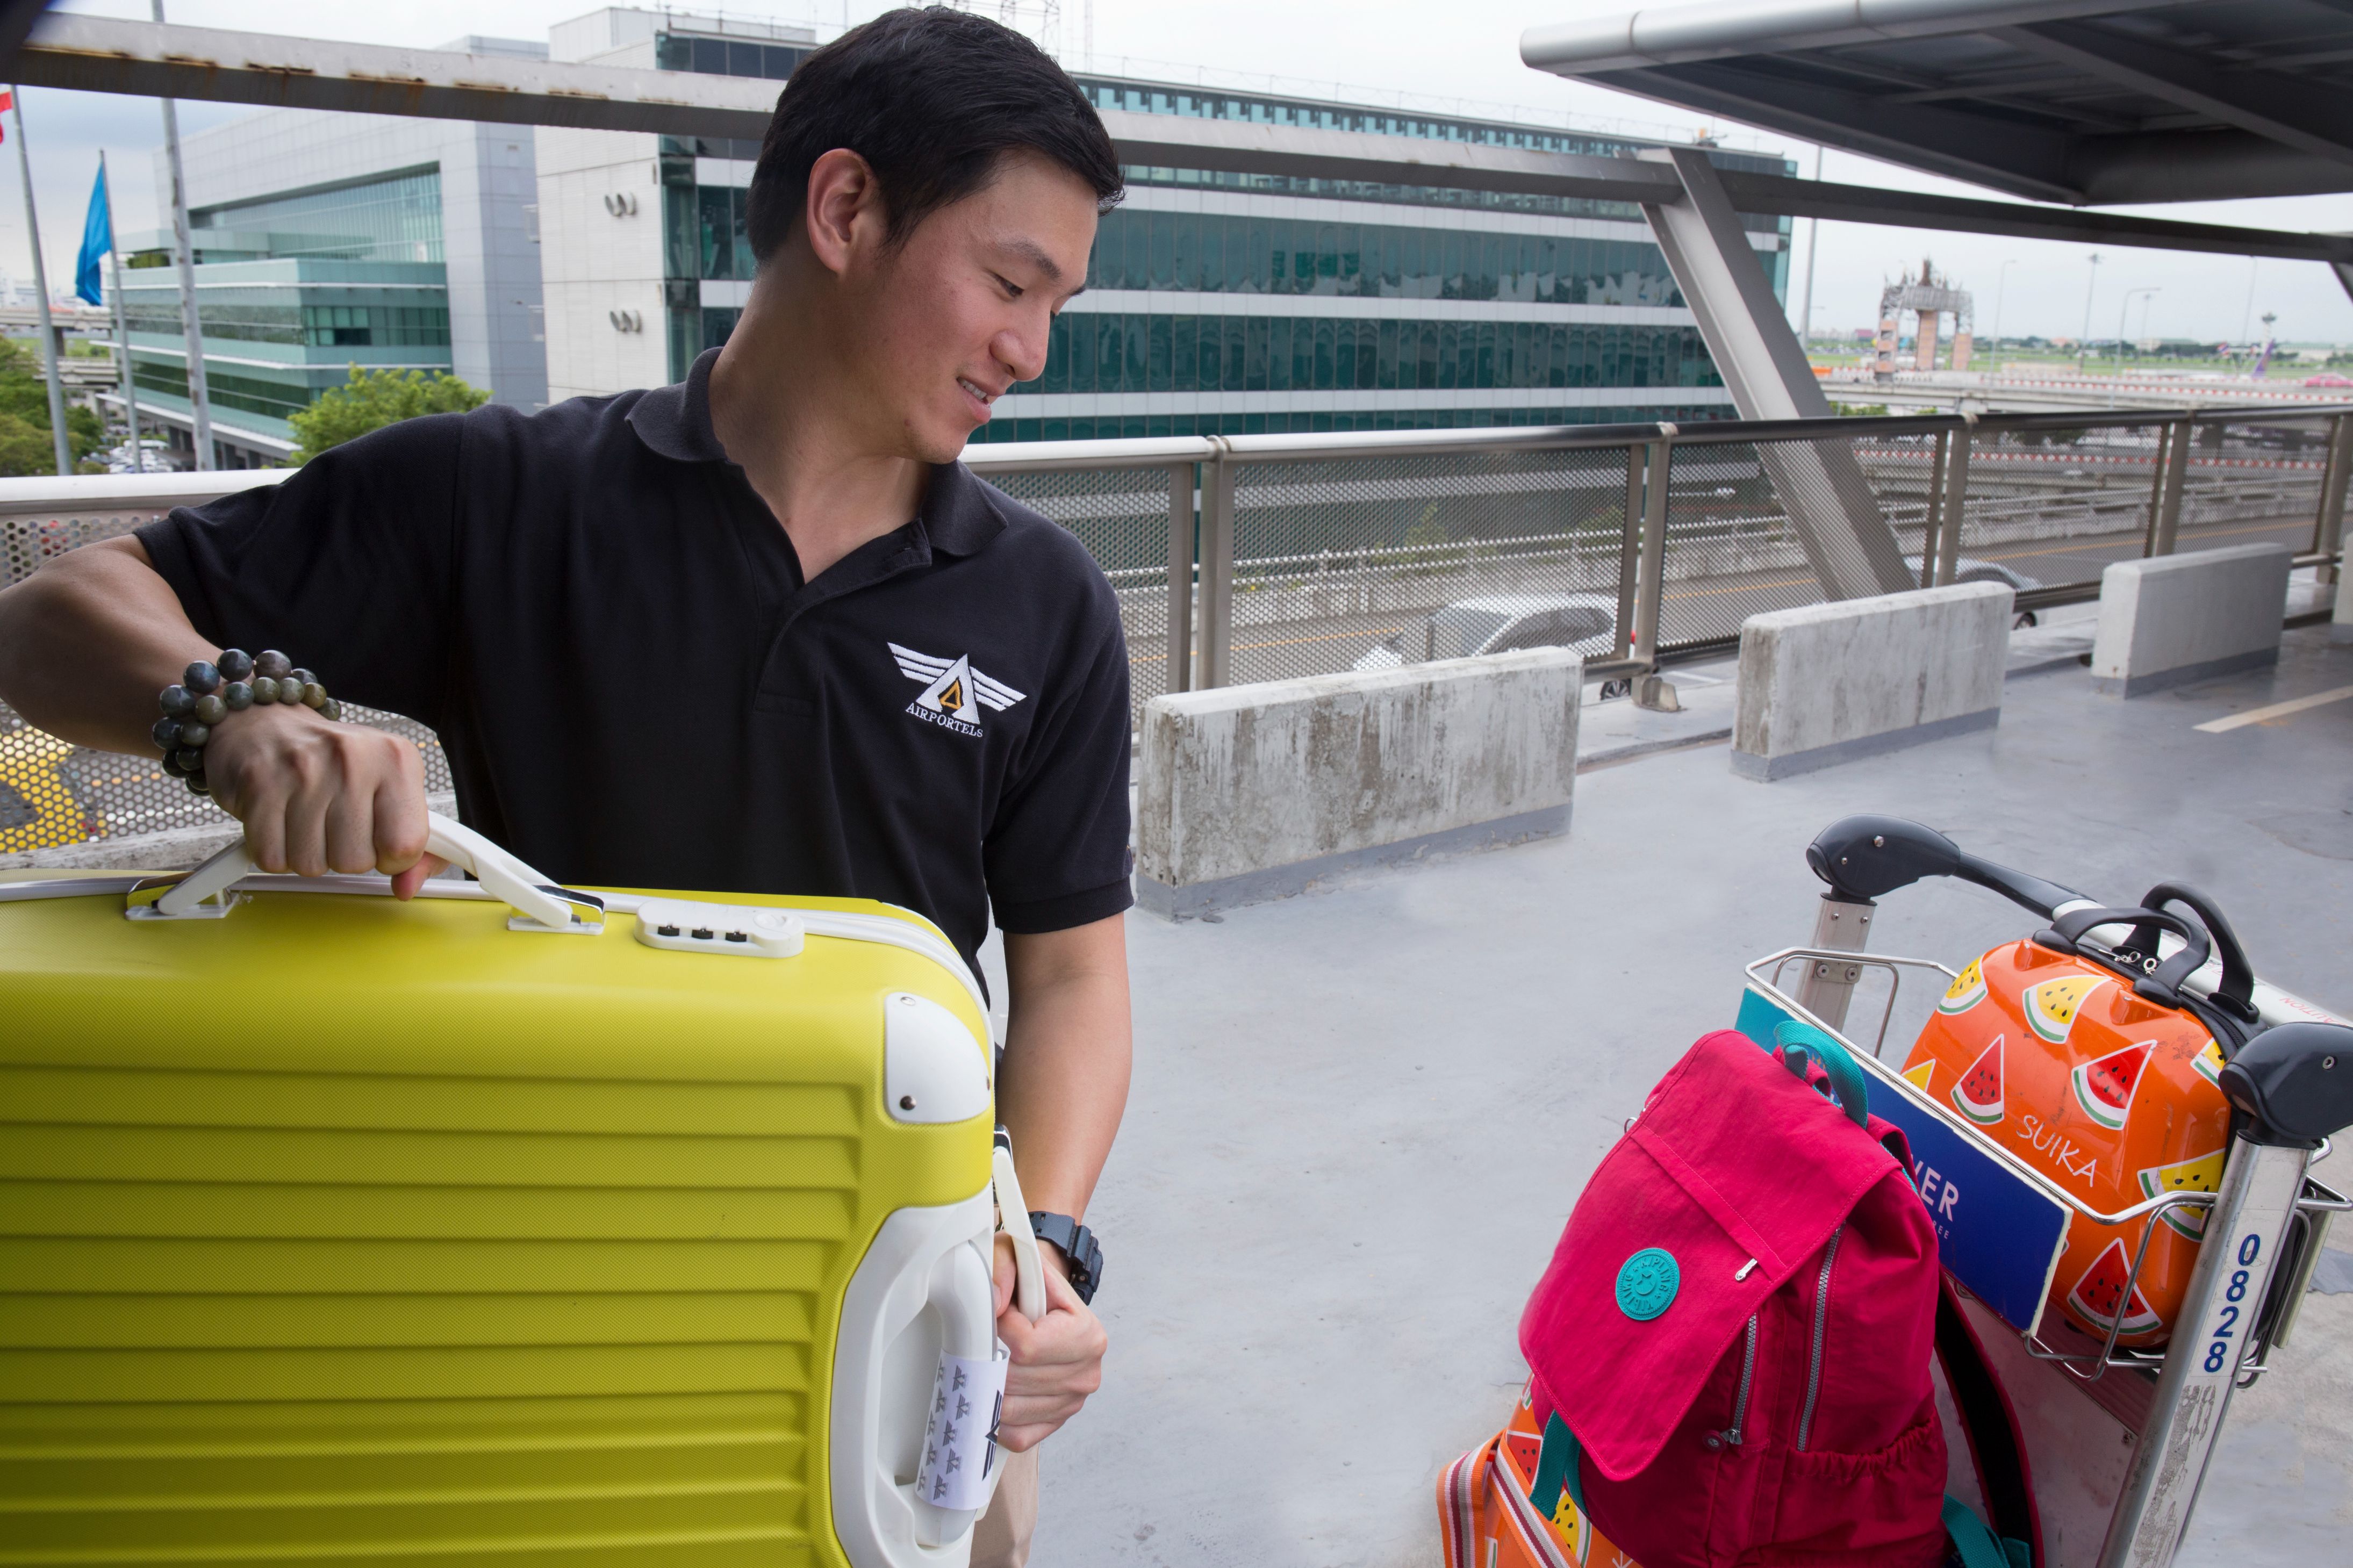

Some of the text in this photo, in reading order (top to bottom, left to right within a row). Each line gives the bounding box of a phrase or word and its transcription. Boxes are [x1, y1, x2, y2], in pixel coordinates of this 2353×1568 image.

[905, 702, 984, 738] AIRPORTELS
[2279, 997, 2348, 1027] AUTION
[2016, 1114, 2097, 1188] SUIKA
[2204, 1234, 2261, 1372] 0828
